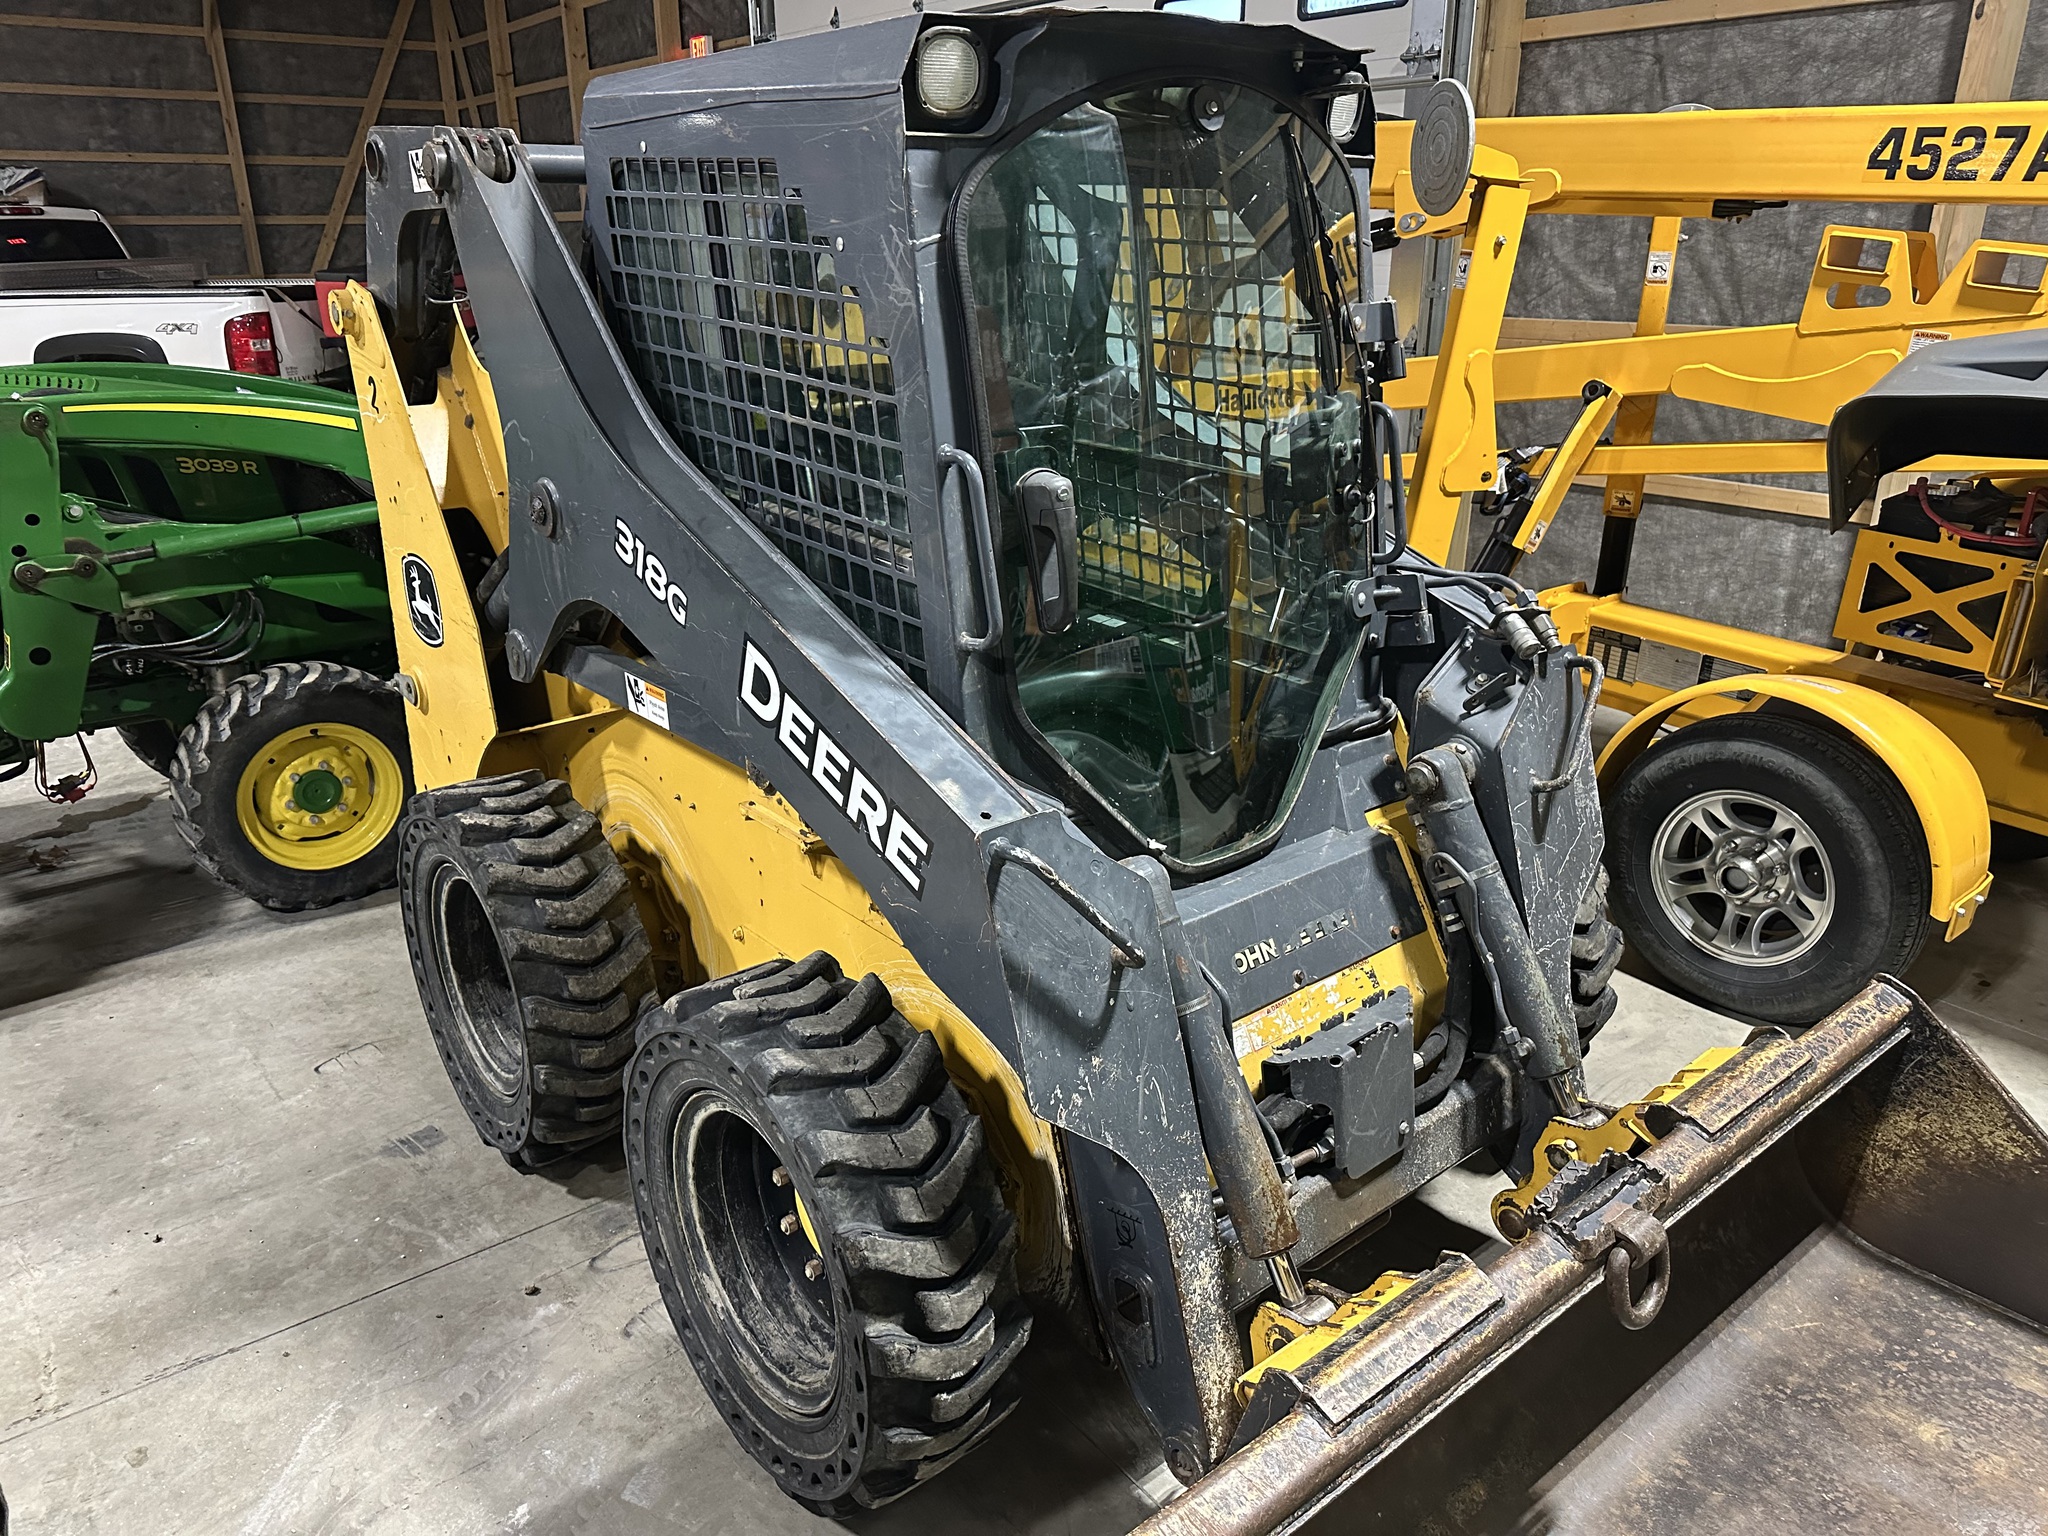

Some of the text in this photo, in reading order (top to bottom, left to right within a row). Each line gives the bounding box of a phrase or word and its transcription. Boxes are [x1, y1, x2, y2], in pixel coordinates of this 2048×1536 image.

[1920, 332, 1948, 340] WARNING
[175, 457, 260, 475] 3039 R
[614, 518, 689, 626] 318G
[740, 640, 929, 892] DEERE
[1271, 997, 1293, 1012] DANGR
